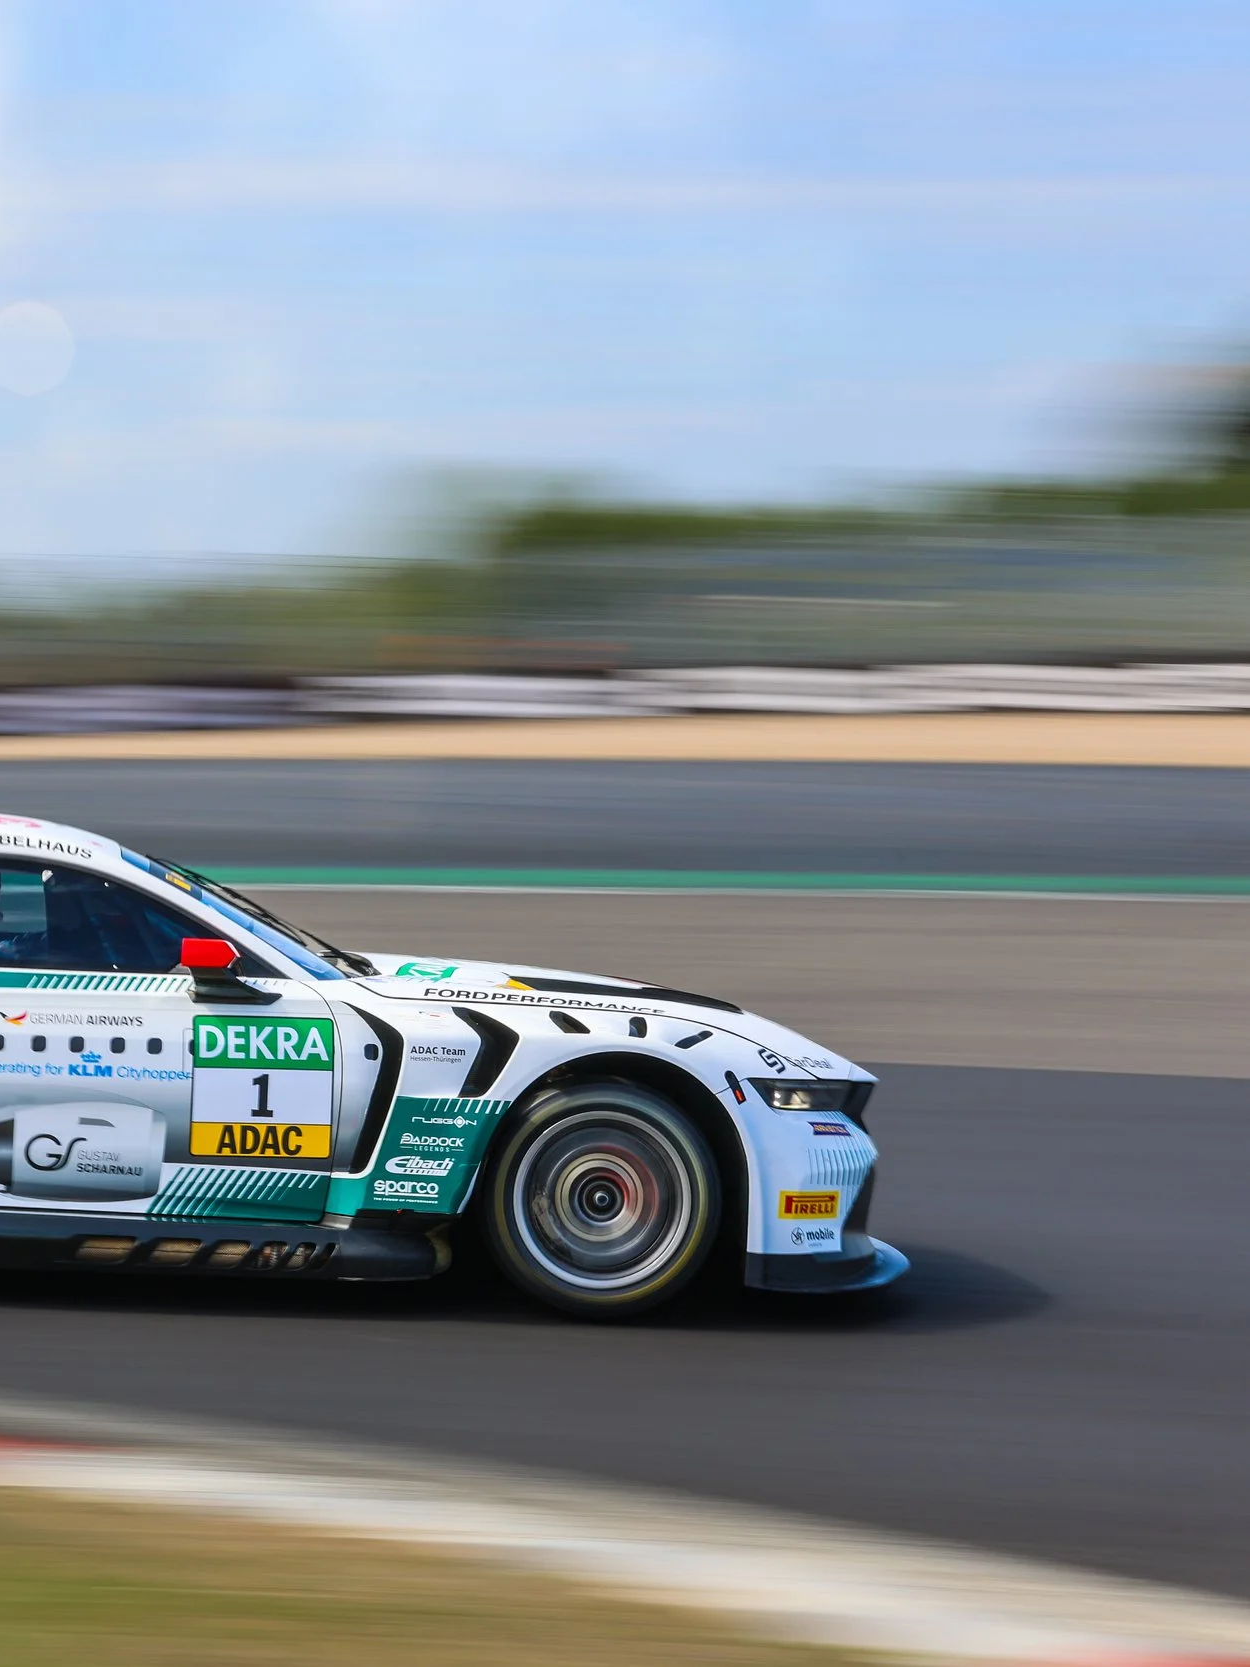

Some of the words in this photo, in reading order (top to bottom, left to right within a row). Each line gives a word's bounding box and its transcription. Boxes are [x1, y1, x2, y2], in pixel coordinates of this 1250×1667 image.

[30, 1013, 83, 1026] GERMAN
[86, 1015, 143, 1027] AIRWAYS
[198, 1024, 329, 1062] DEKRA
[410, 1046, 438, 1055] ADAC
[441, 1046, 466, 1056] Team
[410, 1056, 462, 1064] Hessen-Thüringen
[45, 1062, 63, 1076] for
[68, 1063, 112, 1077] KLM
[116, 1065, 193, 1081] Cityhopper
[251, 1073, 274, 1118] 1
[216, 1125, 303, 1156] ADAC
[400, 1132, 465, 1147] PADDOCK
[77, 1149, 120, 1161] GUSTAV
[75, 1163, 143, 1176] SCHARNAU
[385, 1156, 455, 1176] Eibach
[373, 1180, 439, 1196] sparco
[784, 1195, 836, 1214] PIRELLI
